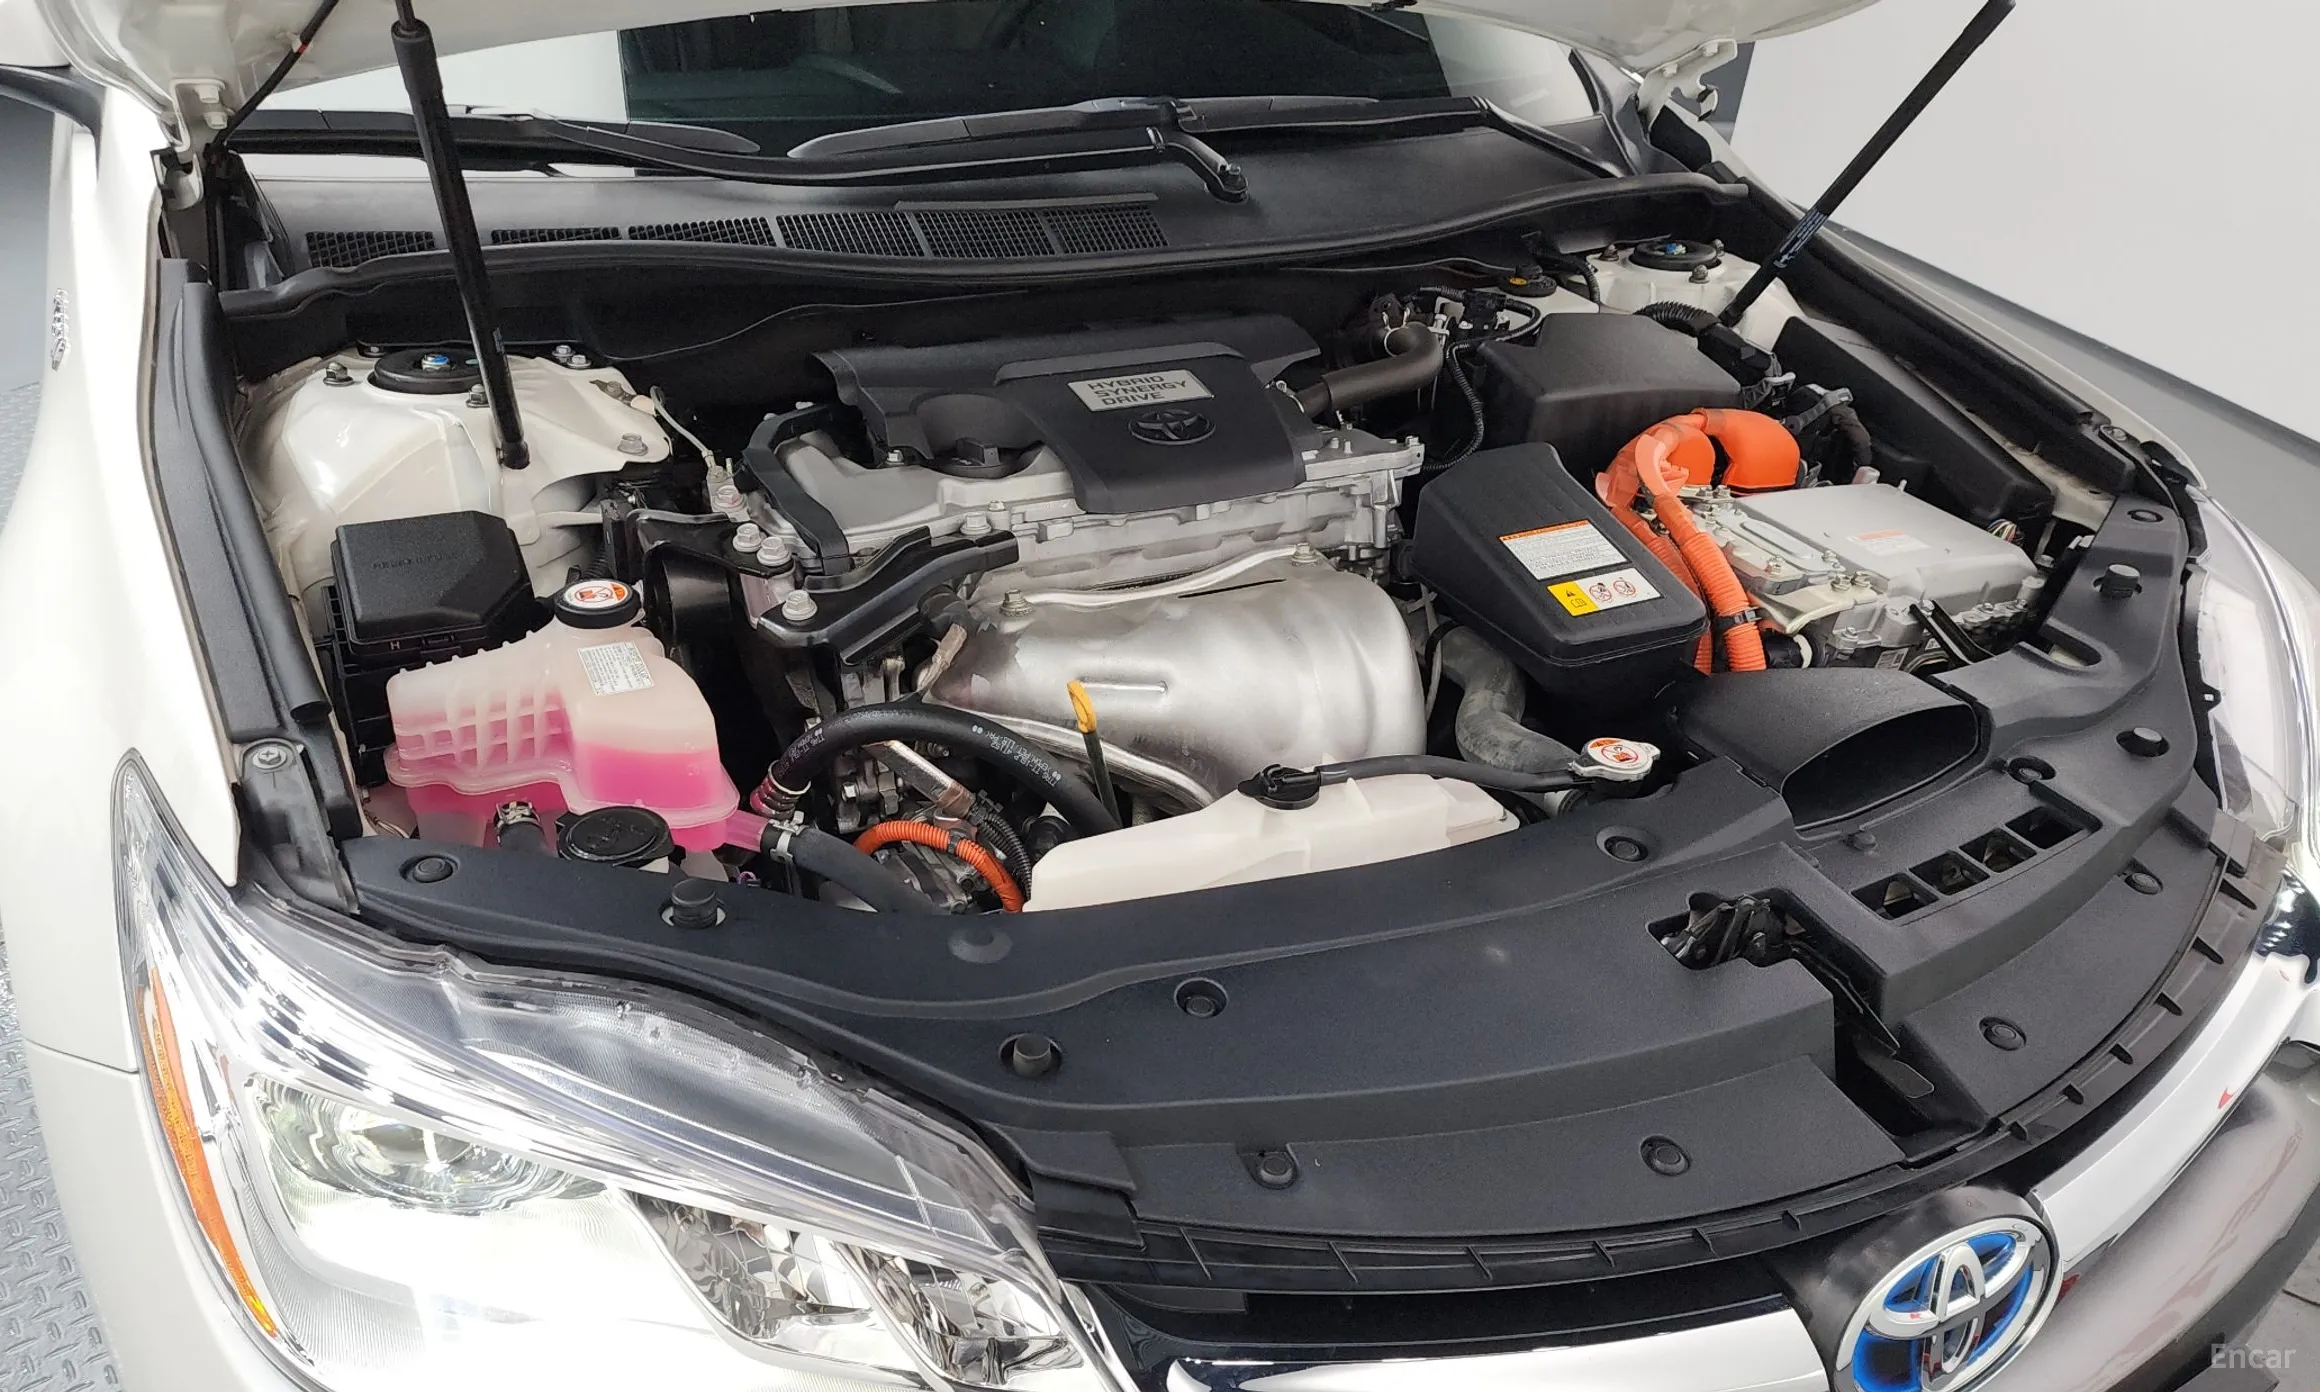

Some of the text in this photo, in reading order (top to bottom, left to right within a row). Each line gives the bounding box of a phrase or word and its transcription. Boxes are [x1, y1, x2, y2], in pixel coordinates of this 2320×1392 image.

[1088, 375, 1164, 390] HYBRID
[1094, 381, 1187, 398] SYNERGY
[1101, 392, 1164, 406] DRIVE
